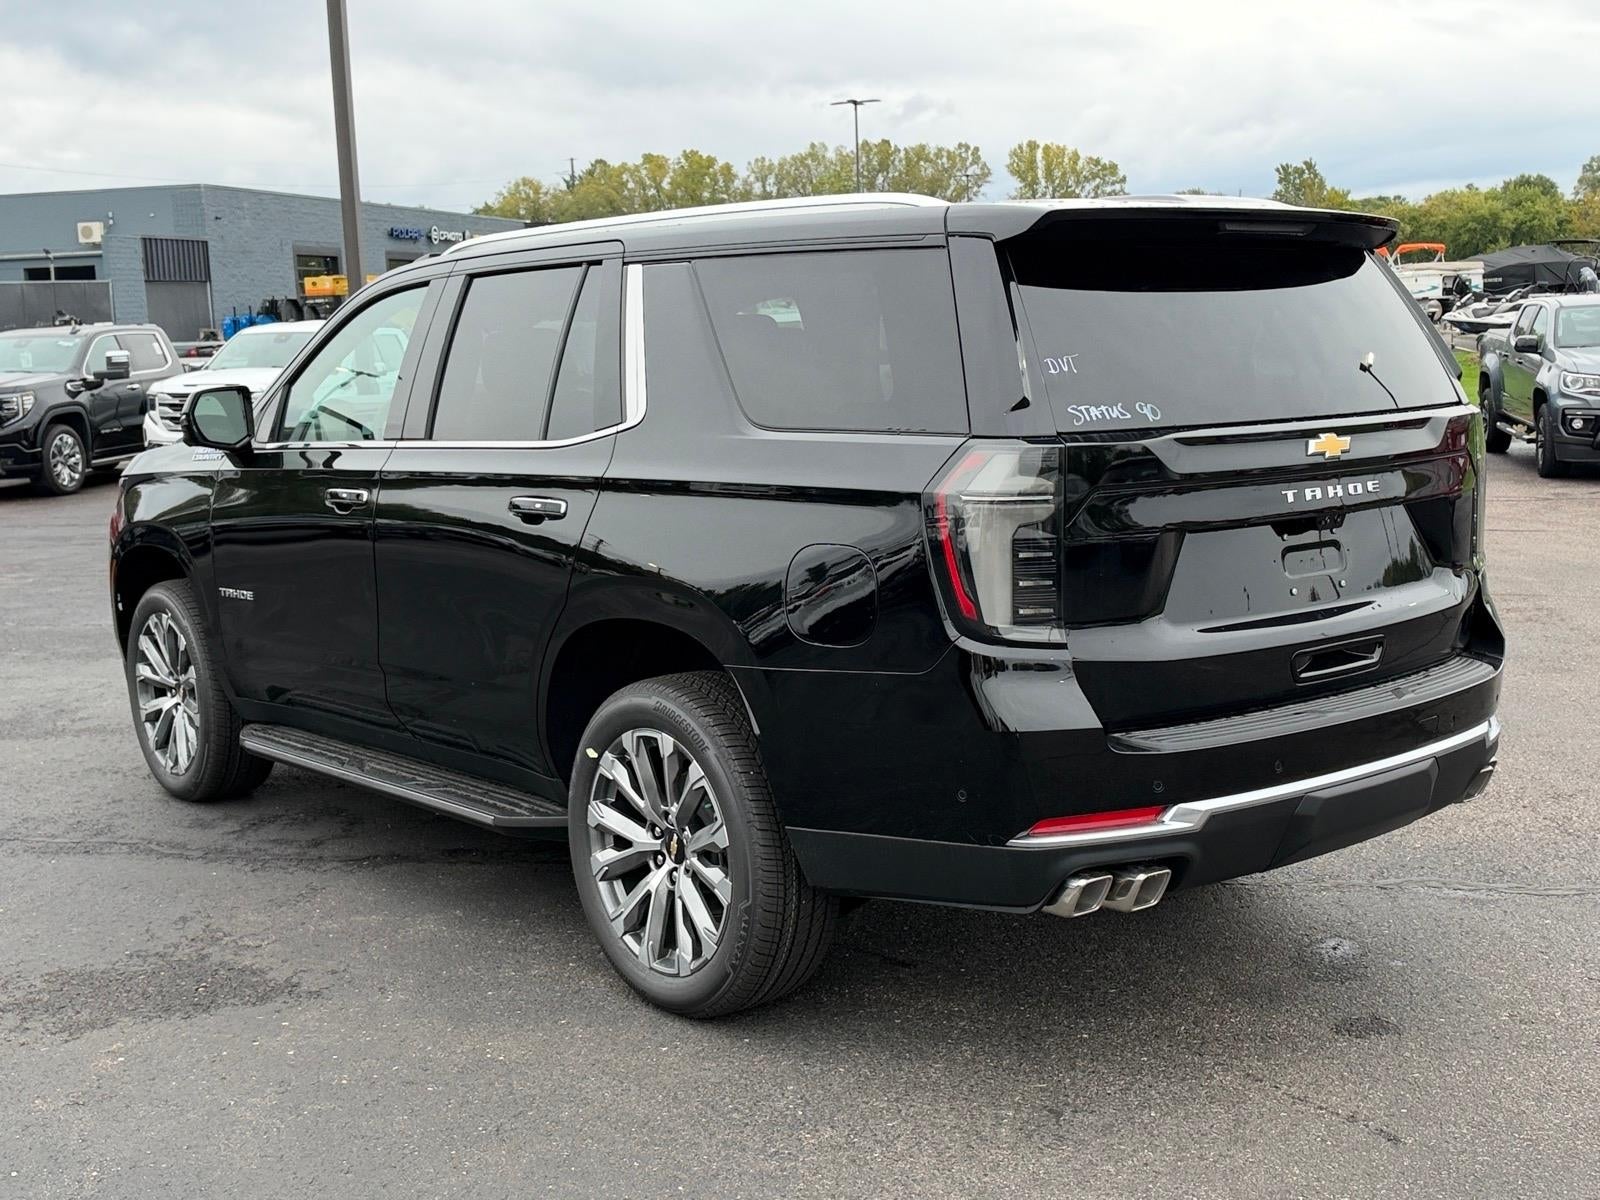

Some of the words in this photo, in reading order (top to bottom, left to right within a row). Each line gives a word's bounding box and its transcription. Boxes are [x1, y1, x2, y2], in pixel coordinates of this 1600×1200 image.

[1043, 353, 1080, 374] DVT
[1066, 402, 1132, 426] STATUS
[1135, 401, 1161, 422] 90
[1281, 480, 1380, 504] TAHOE
[218, 587, 255, 601] TAHOE
[652, 700, 711, 753] BRIDGESTONE
